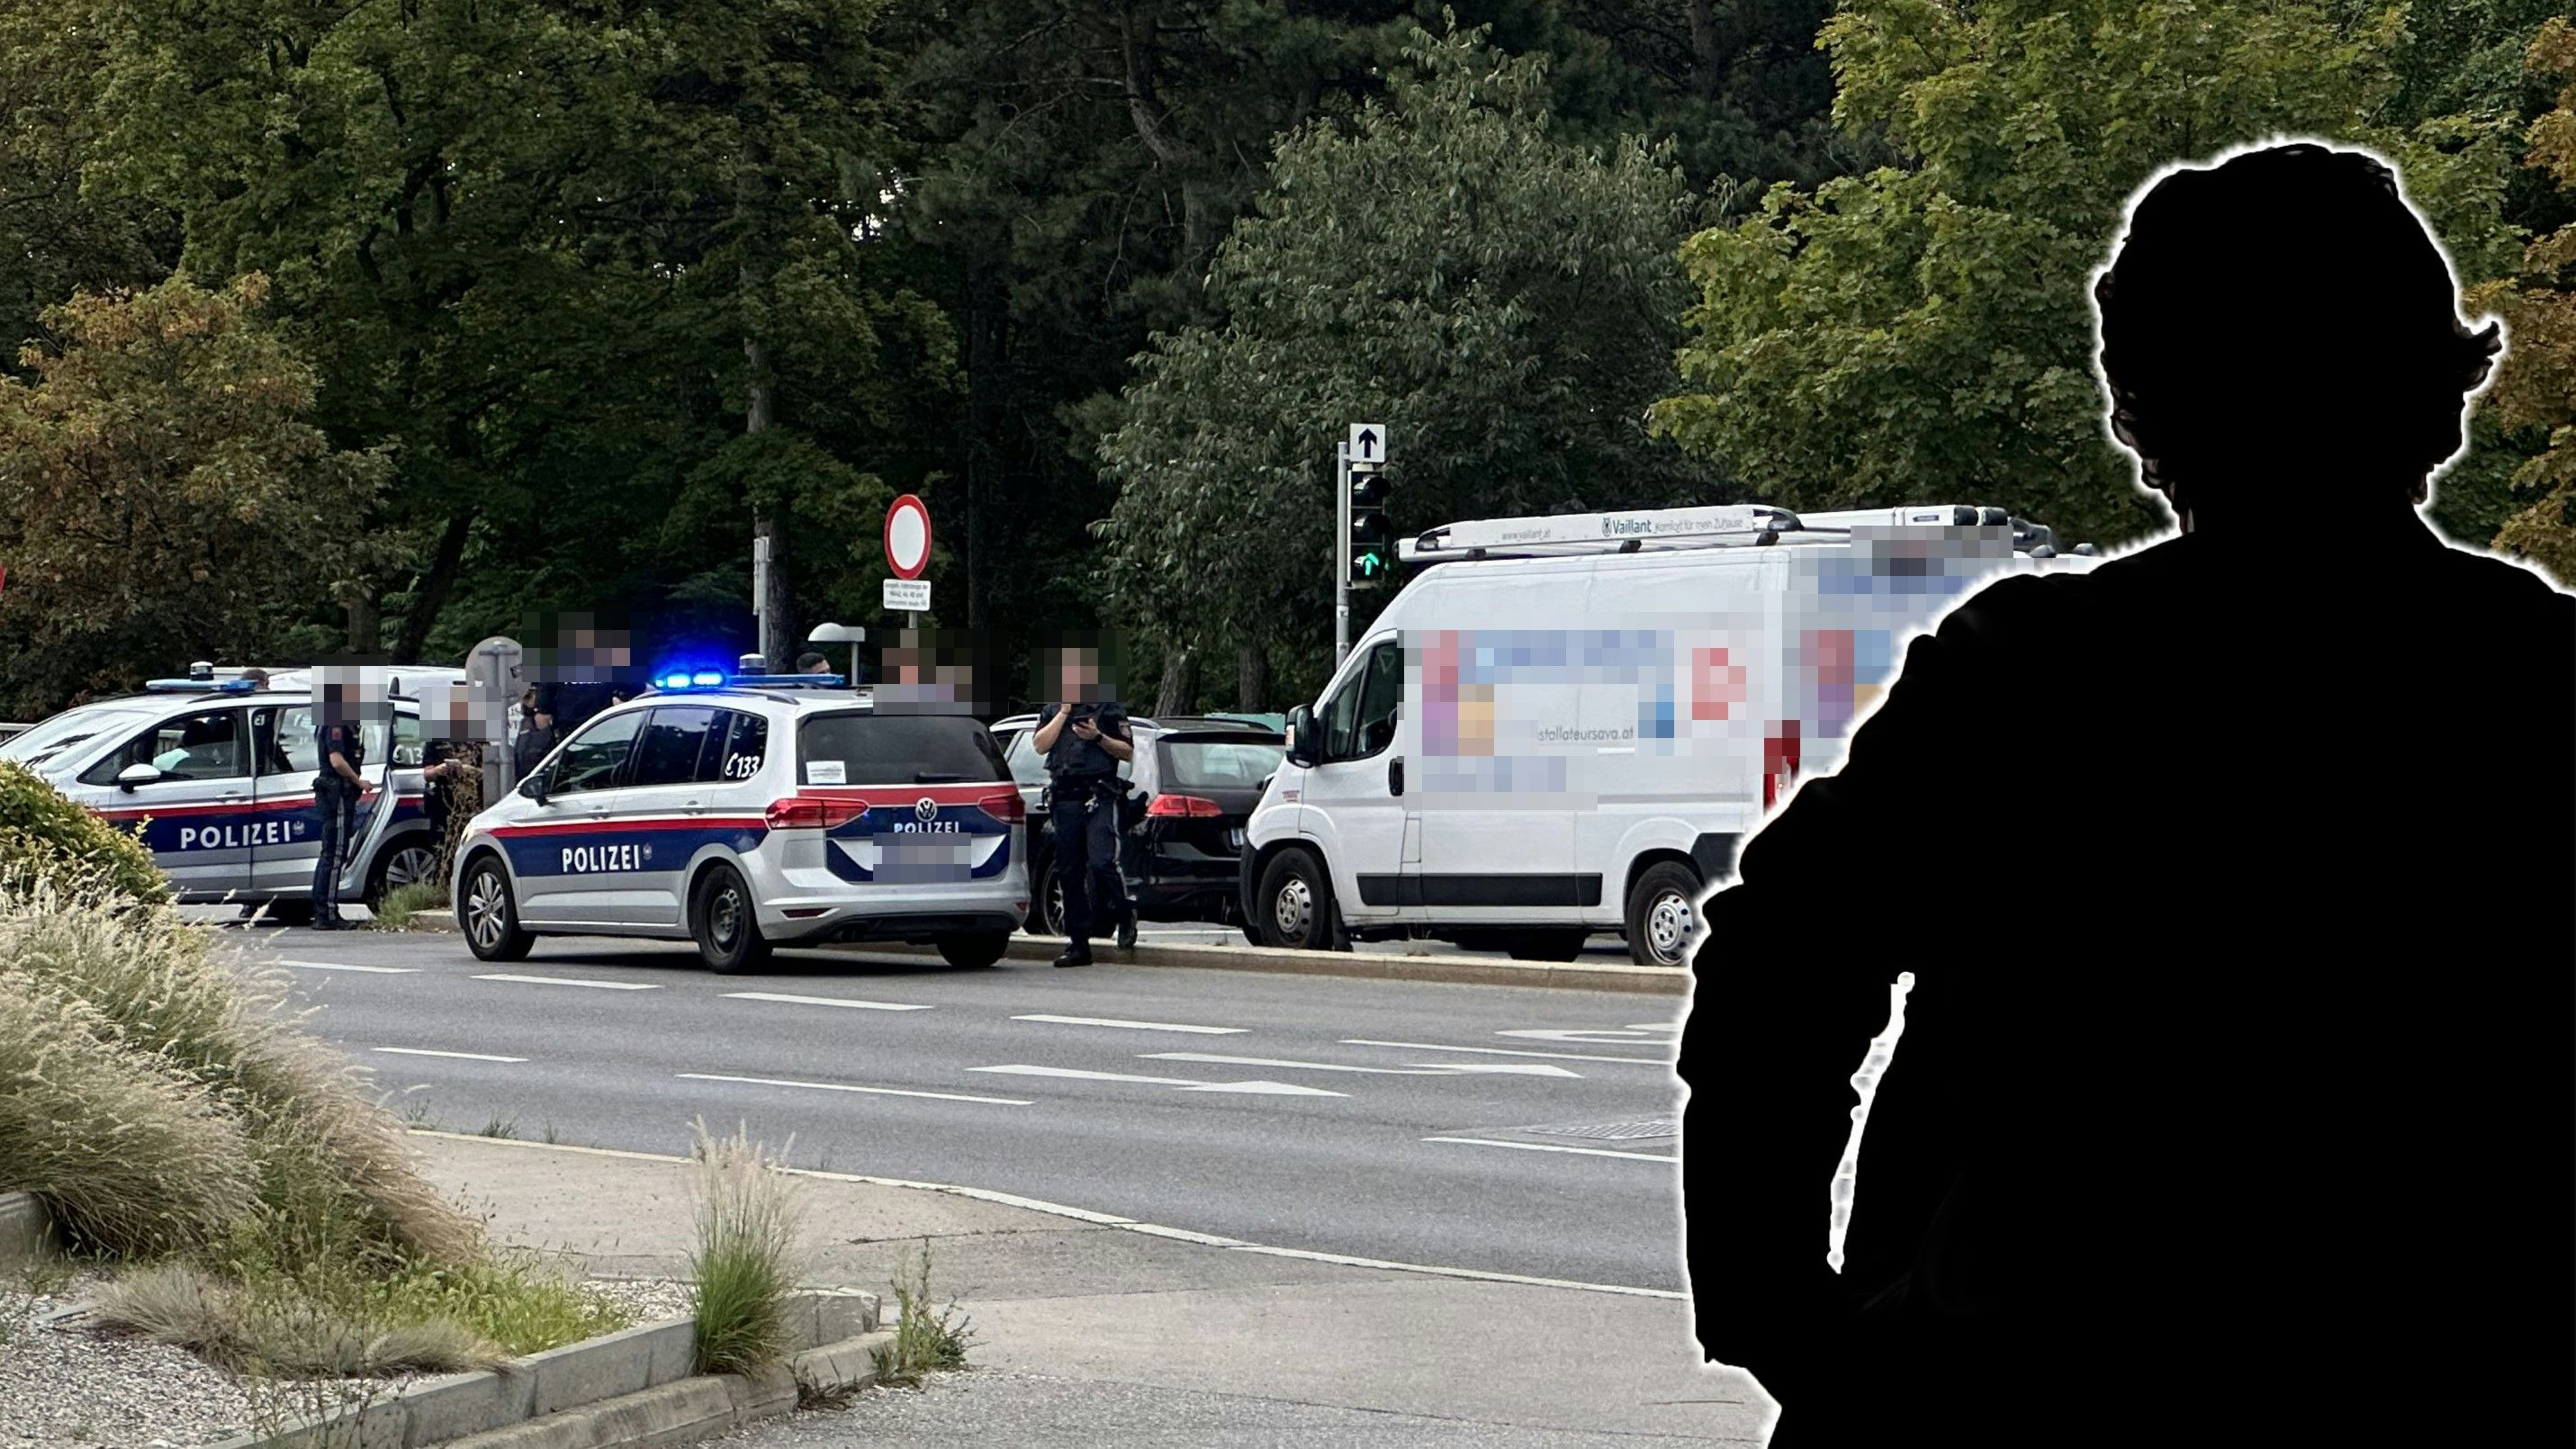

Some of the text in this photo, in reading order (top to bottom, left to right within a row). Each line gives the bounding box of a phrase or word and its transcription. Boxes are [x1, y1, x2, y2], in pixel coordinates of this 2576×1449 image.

[1612, 519, 1652, 535] Vaillant
[1538, 725, 1634, 742] stallateursava.at
[736, 755, 761, 778] 133
[180, 821, 291, 850] POLIZEI
[894, 821, 959, 833] POLIZEI
[562, 844, 640, 873] POLIZEI
